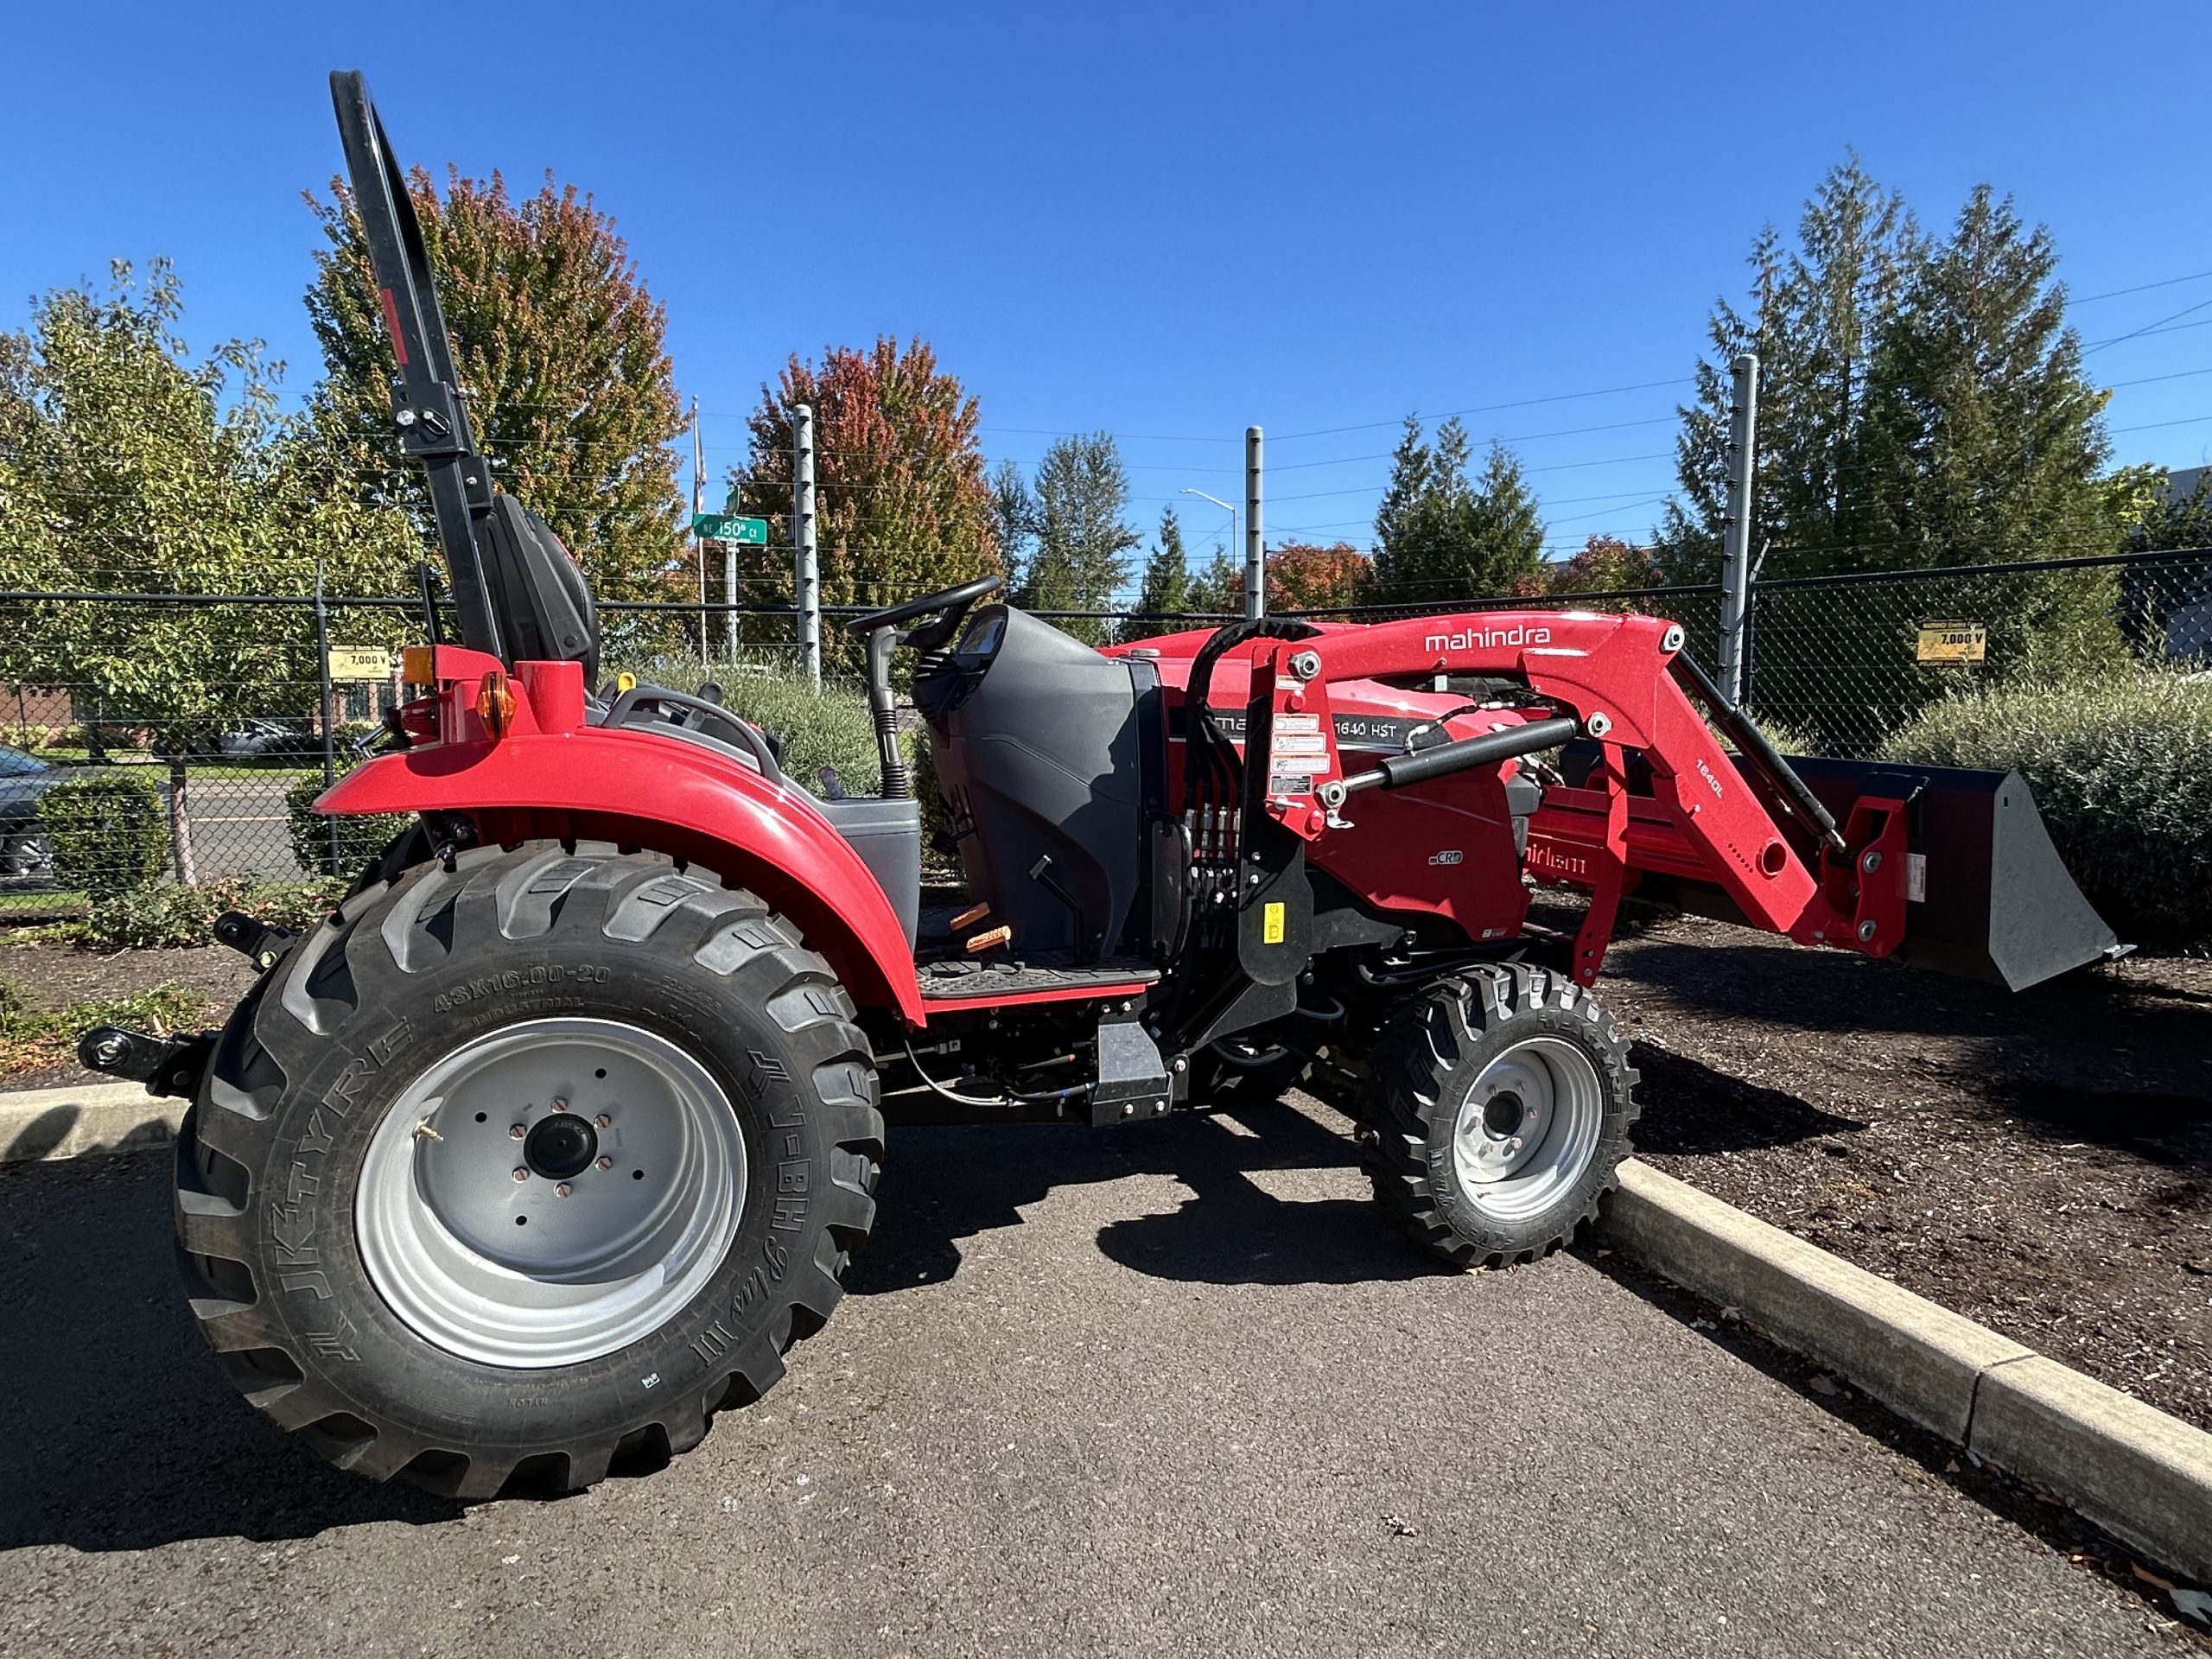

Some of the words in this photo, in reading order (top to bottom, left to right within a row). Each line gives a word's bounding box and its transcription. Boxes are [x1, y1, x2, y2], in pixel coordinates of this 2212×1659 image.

[703, 524, 713, 533] NE
[1425, 624, 1551, 652] mahindra
[1975, 633, 1983, 643] V
[351, 655, 378, 665] 7,000
[380, 656, 385, 664] V
[1335, 721, 1366, 735] 1640
[1371, 723, 1397, 738] HST
[1696, 759, 1724, 799] 1640L
[1429, 851, 1462, 864] mCRD
[433, 964, 612, 1014] 43X16.00-20
[730, 1235, 789, 1322] Plus
